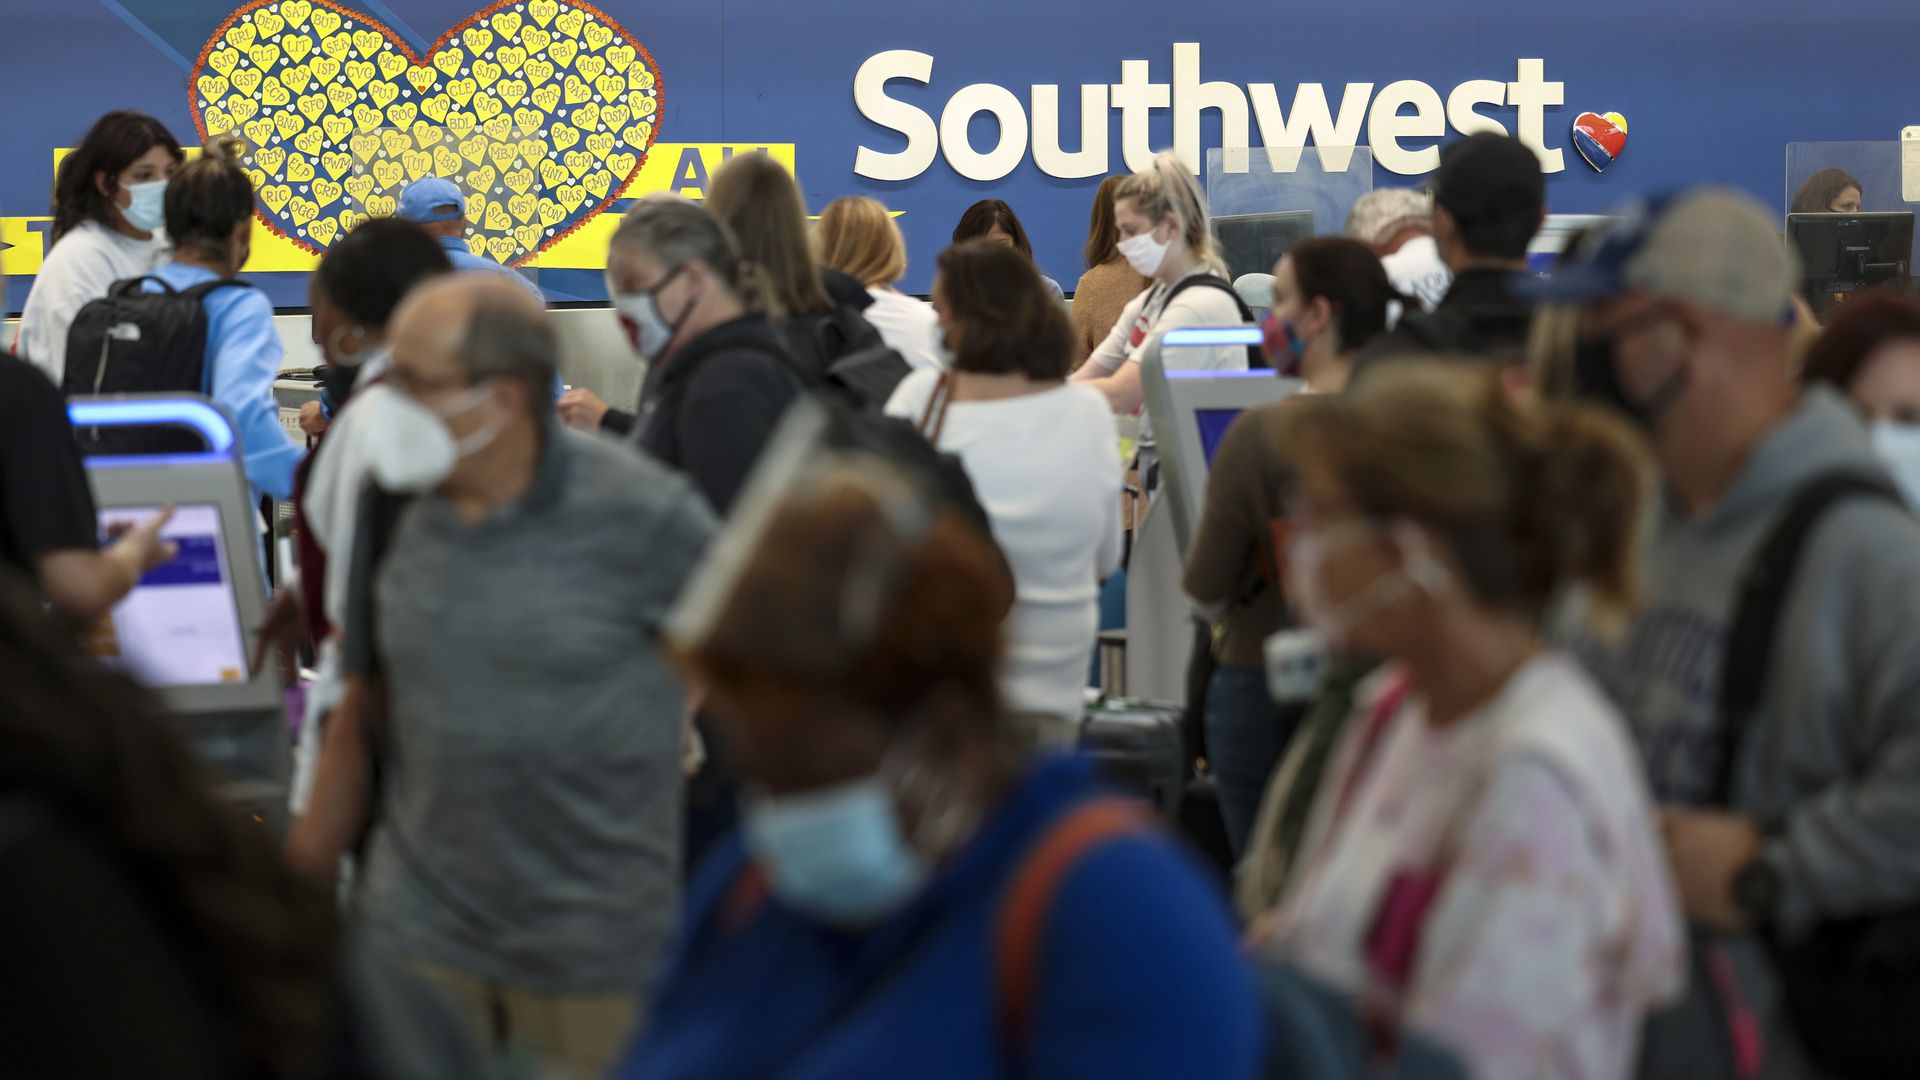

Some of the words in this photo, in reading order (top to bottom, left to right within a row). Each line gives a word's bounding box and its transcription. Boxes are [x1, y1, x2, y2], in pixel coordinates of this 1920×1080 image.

[285, 5, 308, 18] SAT
[532, 4, 555, 18] HOU
[257, 14, 280, 31] DEN
[314, 14, 336, 29] BUF
[493, 17, 517, 31] TUS
[559, 15, 582, 32] CHS
[229, 30, 253, 46] HRL
[355, 35, 380, 48] SMF
[464, 33, 488, 46] MAF
[524, 30, 546, 46] BUR
[586, 27, 608, 44] KOA
[287, 39, 308, 52] LIT
[326, 38, 350, 54] SEA
[552, 45, 573, 60] PBI
[213, 53, 236, 68] SJU
[252, 49, 275, 62] CLT
[377, 54, 401, 72] MCI
[438, 52, 462, 68] PDX
[500, 52, 522, 65] BOI
[610, 51, 632, 64] PHL
[317, 62, 336, 74] ISP
[347, 66, 373, 79] CVG
[476, 64, 497, 80] SJD
[526, 63, 549, 78] GEG
[578, 60, 600, 73] AUS
[234, 73, 257, 85] GSP
[285, 68, 309, 84] JAX
[409, 71, 433, 83] BWI
[628, 63, 654, 90] MDW
[200, 81, 226, 93] AMA
[264, 81, 286, 103] ECP
[372, 86, 394, 99] PUJ
[449, 82, 473, 97] CLE
[500, 84, 524, 96] LGB
[566, 79, 588, 102] OAK
[602, 79, 625, 92] IAD
[329, 89, 352, 104] GRR
[535, 89, 561, 106] PHX
[231, 101, 256, 117] RSW
[302, 99, 324, 113] SFO
[427, 100, 448, 117] ITO
[476, 97, 498, 114] SJC
[631, 97, 652, 112] SJO
[853, 43, 1565, 181] Southwest
[205, 111, 230, 131] OMA
[357, 109, 380, 125] SDF
[392, 107, 415, 120] ROC
[518, 113, 540, 126] SNA
[574, 107, 599, 126] BZE
[603, 109, 629, 122] DSM
[277, 115, 298, 131] BNA
[327, 122, 349, 134] STL
[449, 118, 472, 129] BDL
[486, 118, 509, 136] MSP
[248, 124, 272, 138] PVR
[417, 127, 437, 141] LIR
[552, 128, 575, 143] BOS
[625, 126, 650, 143] HAV
[298, 130, 322, 151] OKC
[353, 140, 375, 151] ORF
[385, 136, 407, 150] ATL
[461, 139, 486, 157] CZM
[589, 137, 613, 150] RNO
[256, 149, 285, 165] MEM
[490, 147, 515, 160] MBJ
[521, 144, 545, 157] LGA
[289, 157, 310, 178] ELP
[323, 157, 352, 170] PWM
[404, 156, 426, 172] TUL
[435, 151, 457, 173] LBB
[565, 155, 593, 168] GCM
[612, 157, 633, 170] ICT
[377, 168, 398, 180] PLS
[468, 171, 494, 187] MKE
[505, 173, 531, 188] BHM
[542, 164, 564, 183] HNL
[347, 180, 372, 193] RDU
[585, 173, 611, 191] CMH
[266, 189, 288, 203] RIC
[315, 183, 338, 198] CRP
[560, 190, 582, 202] NAS
[291, 201, 315, 220] OGG
[369, 201, 394, 215] SAN
[464, 199, 482, 215] AS
[511, 199, 534, 215] MSY
[539, 203, 563, 221] CUN
[488, 207, 509, 228] SLC
[312, 222, 335, 237] PNS
[517, 228, 544, 240] DTW
[470, 238, 481, 252] IT
[490, 241, 515, 253] MCO
